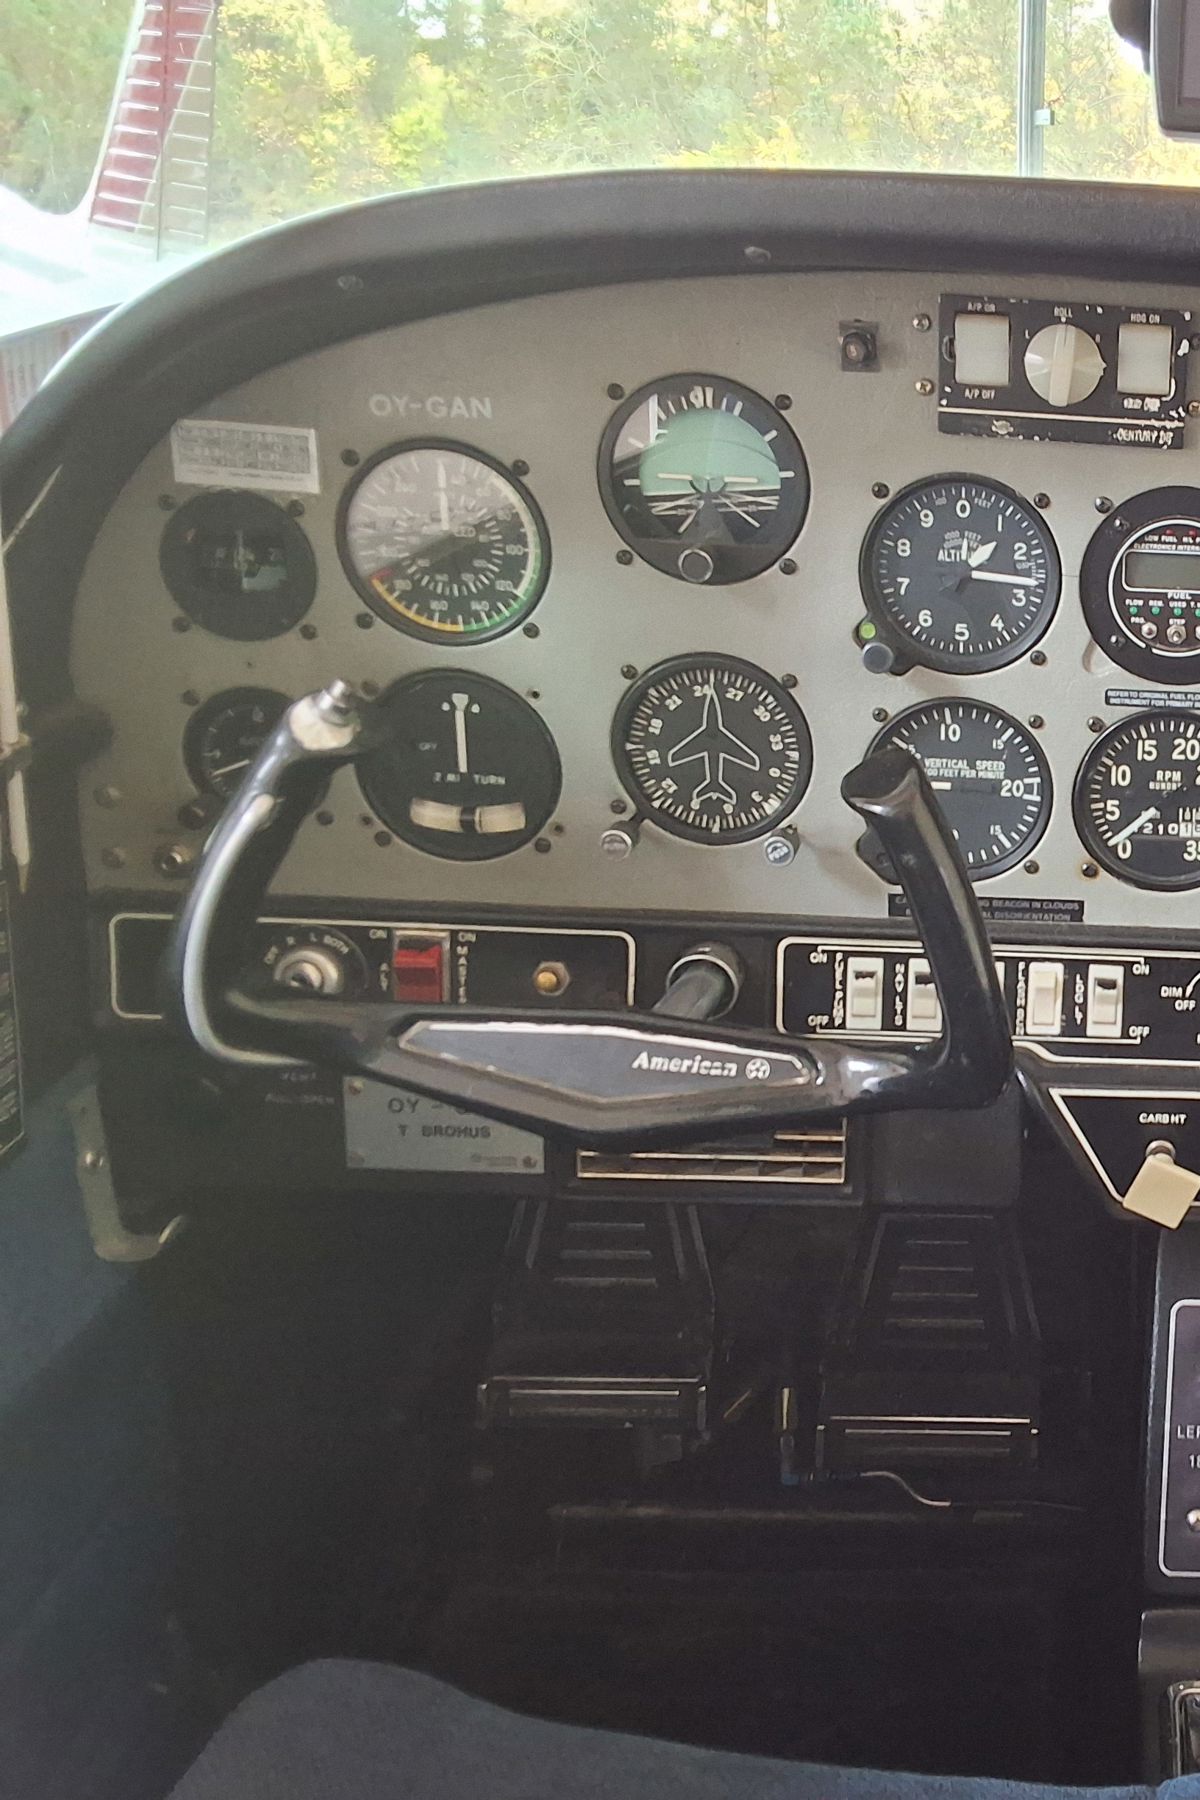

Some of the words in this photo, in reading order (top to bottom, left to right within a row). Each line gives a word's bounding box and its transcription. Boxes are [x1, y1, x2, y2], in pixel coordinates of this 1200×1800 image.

[1054, 307, 1072, 318] ROLL
[982, 389, 995, 399] OFF
[369, 394, 492, 419] OY-GAN
[956, 500, 970, 518] 0
[920, 509, 934, 528] 9
[1161, 535, 1178, 543] FUEL
[897, 538, 911, 557] 8
[1014, 542, 1027, 561] 2
[896, 577, 910, 596] 7
[1012, 588, 1026, 607] 3
[1167, 592, 1192, 600] FUEL
[918, 609, 933, 627] 6
[990, 613, 1005, 631] 4
[954, 623, 969, 641] 5
[940, 723, 961, 742] 10
[992, 738, 1004, 750] 15
[1137, 739, 1158, 761] 15
[1171, 738, 1200, 760] 20
[925, 758, 970, 769] VERTICAL
[975, 760, 1006, 771] SPEED
[473, 774, 506, 785] TURN
[939, 769, 959, 778] FEET
[960, 770, 976, 778] PER
[977, 771, 1005, 779] MINUTE
[1110, 765, 1131, 787] 10
[1156, 769, 1181, 782] RPM
[1000, 779, 1024, 798] 20
[1106, 800, 1120, 821] 5
[1117, 841, 1132, 859] 0
[992, 900, 1029, 909] BEACON
[1032, 901, 1041, 909] IN
[1043, 902, 1079, 910] CLOUDS
[994, 911, 1071, 921] DISORIENTATION
[369, 929, 387, 939] ON
[457, 932, 477, 942] ON
[810, 952, 827, 963] ON
[1132, 964, 1150, 975] ON
[1161, 986, 1183, 998] DIM
[1175, 1000, 1196, 1011] OFF
[808, 1015, 829, 1026] OFF
[1129, 1025, 1150, 1038] OFF
[632, 1051, 738, 1077] American
[1139, 1113, 1170, 1125] CARB
[1170, 1113, 1186, 1125] HT
